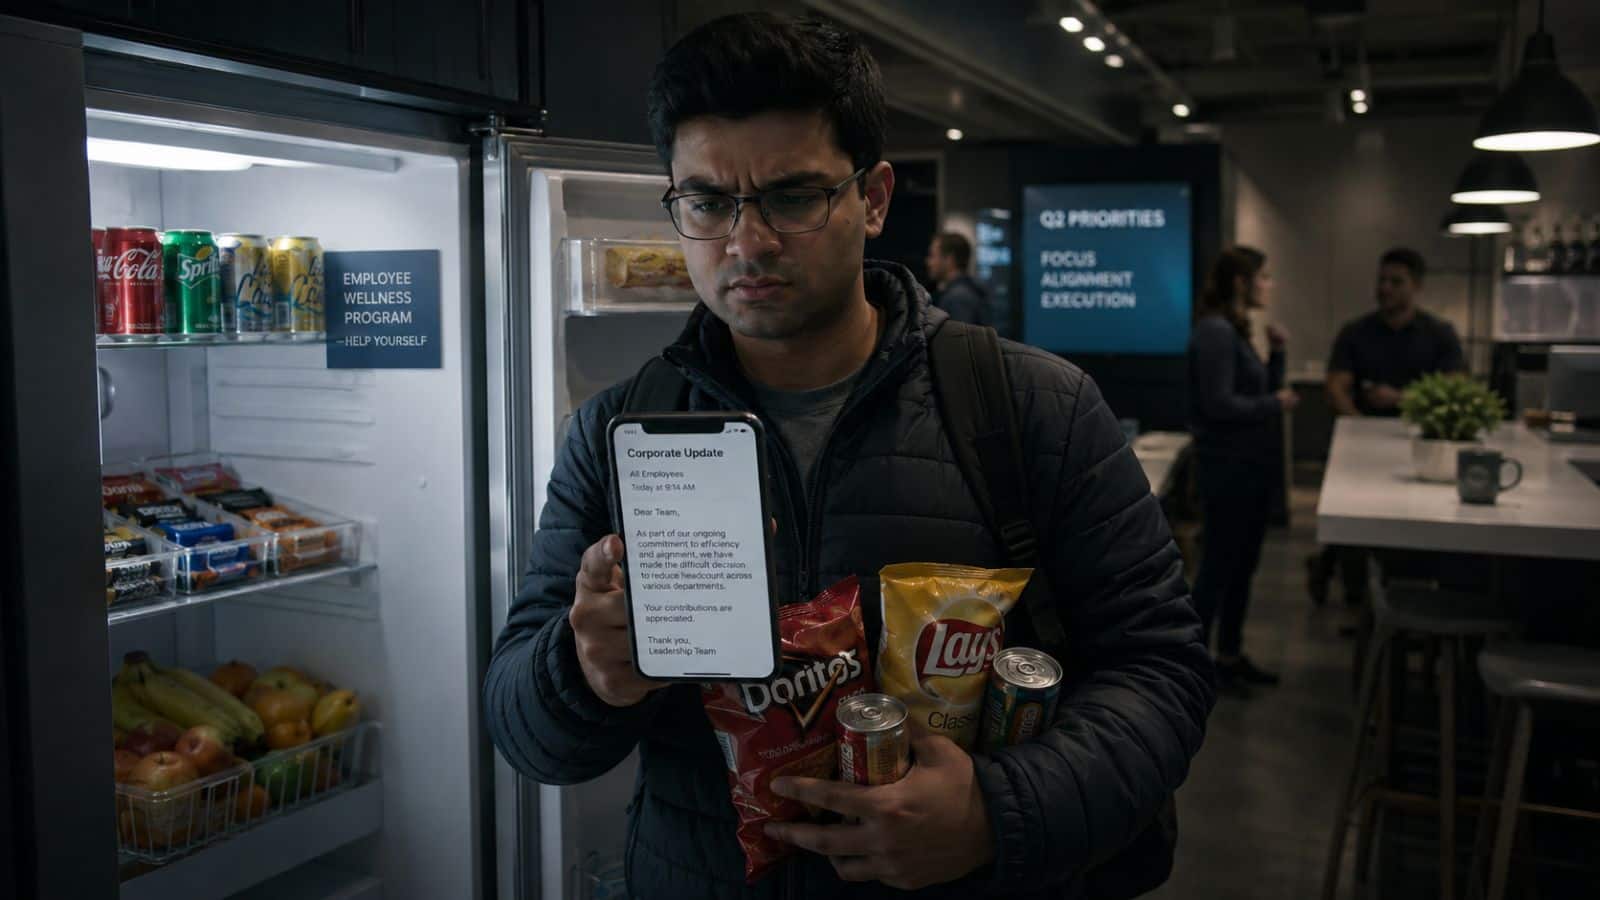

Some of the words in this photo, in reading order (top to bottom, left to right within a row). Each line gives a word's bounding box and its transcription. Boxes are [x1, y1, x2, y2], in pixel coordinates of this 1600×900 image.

[1040, 210, 1065, 228] Q2
[1068, 209, 1165, 228] PRIORITIES
[1041, 251, 1096, 267] FOCUS
[343, 272, 412, 285] EMPLOYEE
[1041, 271, 1134, 288] ALIGNMENT
[344, 291, 412, 304] WELLNESS
[1041, 291, 1136, 309] EXECUTION
[344, 311, 412, 324] PROGRAM
[374, 336, 428, 347] YOURSELF
[627, 448, 681, 460] Corporate
[684, 448, 724, 460] Update
[630, 470, 640, 478] All
[642, 470, 684, 480] Employees
[632, 483, 654, 493] Today
[656, 484, 663, 492] at
[665, 483, 681, 492] 9:14
[682, 483, 696, 492] AM
[634, 508, 653, 517] Dear
[655, 508, 680, 518] Team,
[636, 529, 647, 538] As
[649, 530, 665, 541] part
[667, 529, 676, 537] of
[692, 530, 726, 541] ongoing
[638, 540, 688, 549] commitment
[690, 540, 699, 549] to
[701, 540, 740, 552] efficiency
[639, 550, 654, 559] and
[656, 550, 698, 562] alignment,
[713, 550, 733, 559] have
[640, 561, 663, 569] made
[665, 561, 677, 569] the
[680, 560, 710, 569] difficult
[711, 561, 746, 569] decision
[641, 572, 650, 580] to
[651, 572, 679, 580] reduce
[681, 572, 724, 580] headcount
[642, 582, 671, 591] various
[673, 582, 726, 593] departments.
[644, 603, 662, 612] Your
[664, 603, 718, 612] contributions
[646, 614, 696, 625] appreciated.
[648, 636, 672, 645] Thank
[674, 638, 691, 647] you,
[648, 647, 693, 658] Leadership
[694, 647, 717, 656] Team
[741, 649, 862, 714] Doritos
